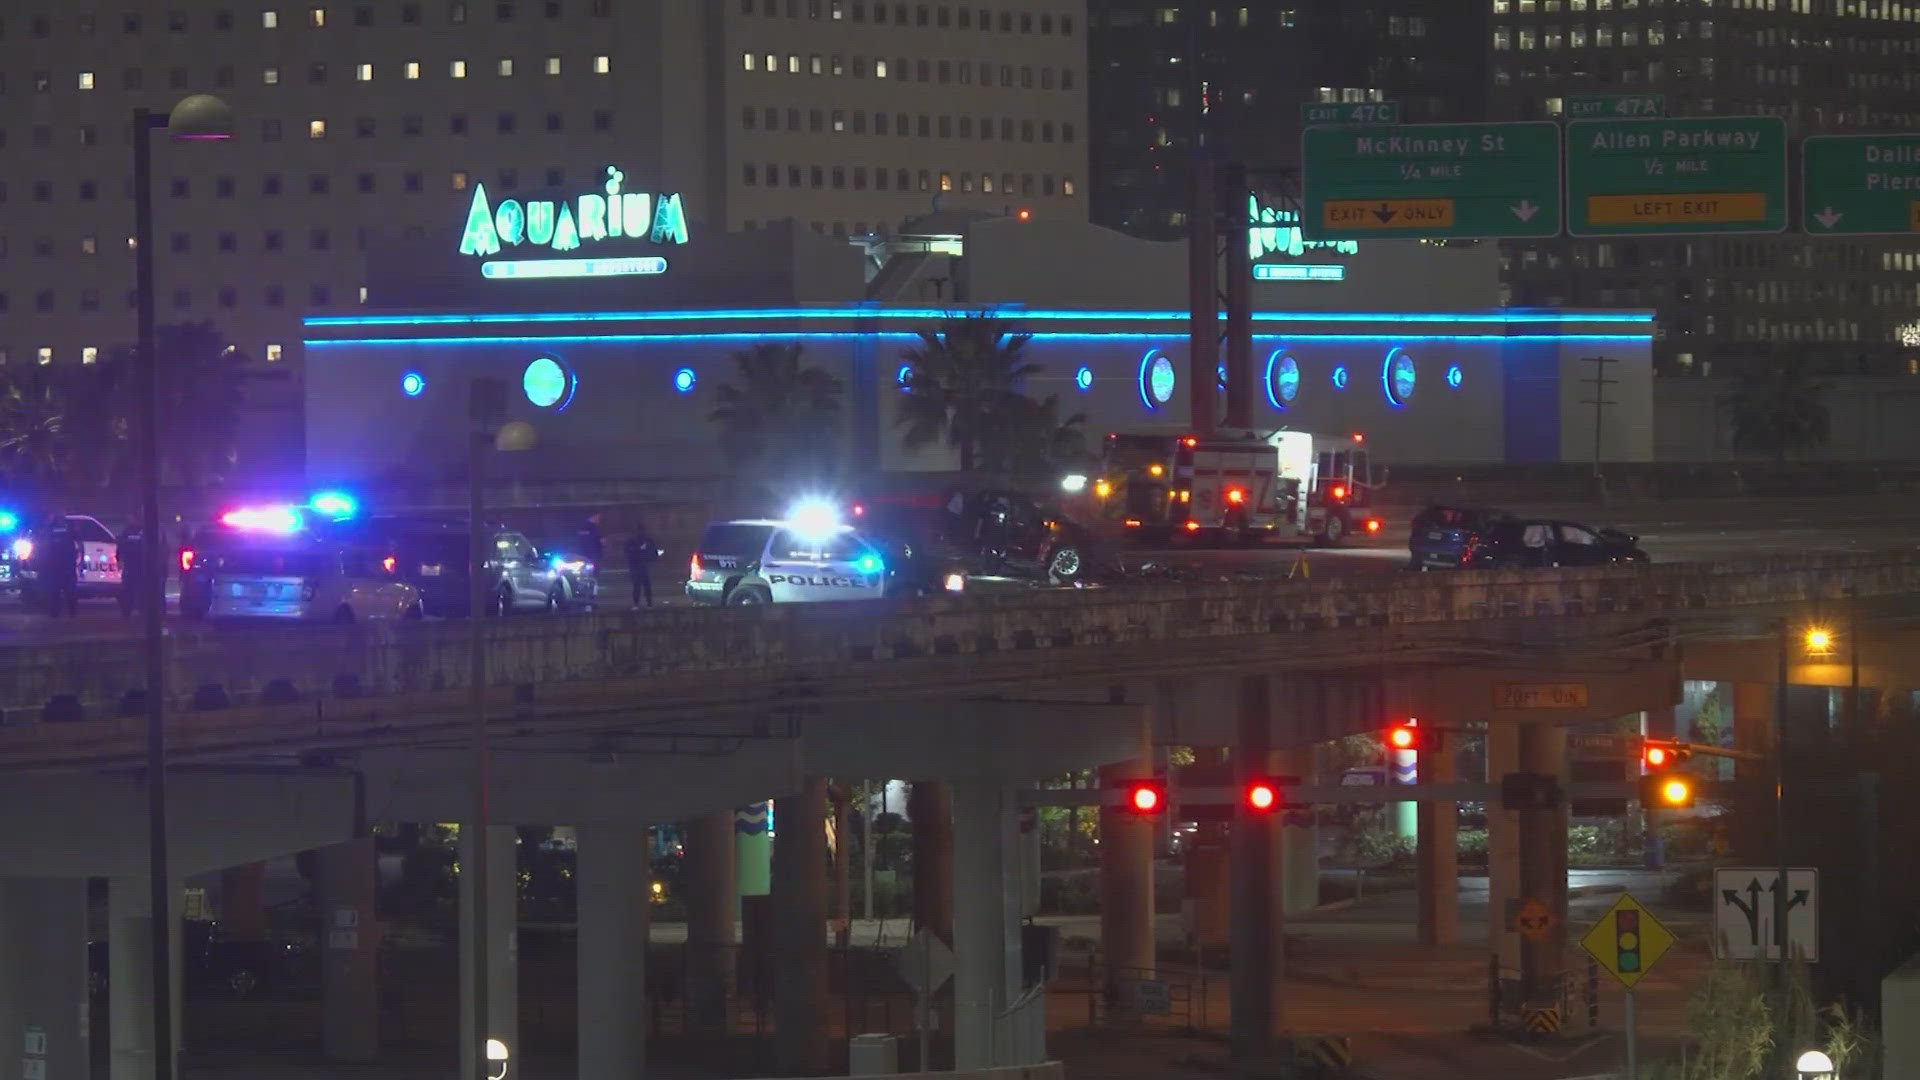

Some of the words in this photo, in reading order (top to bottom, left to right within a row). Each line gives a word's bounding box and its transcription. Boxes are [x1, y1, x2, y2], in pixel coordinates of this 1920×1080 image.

[1309, 108, 1338, 121] EXIT
[1351, 105, 1390, 121] 47C
[1573, 102, 1601, 113] EXIT
[1616, 99, 1658, 114] 47A
[1356, 137, 1469, 156] McKinney
[1481, 134, 1505, 151] St
[1592, 131, 1650, 149] Allen
[1663, 130, 1760, 149] Parkway
[1429, 164, 1462, 177] MILE
[1675, 160, 1709, 173] MILE
[1330, 208, 1365, 222] EXIT
[1404, 207, 1445, 220] ONLY
[1633, 203, 1672, 216] LEFT
[1684, 202, 1720, 215] EXIT
[768, 574, 866, 588] POLICE
